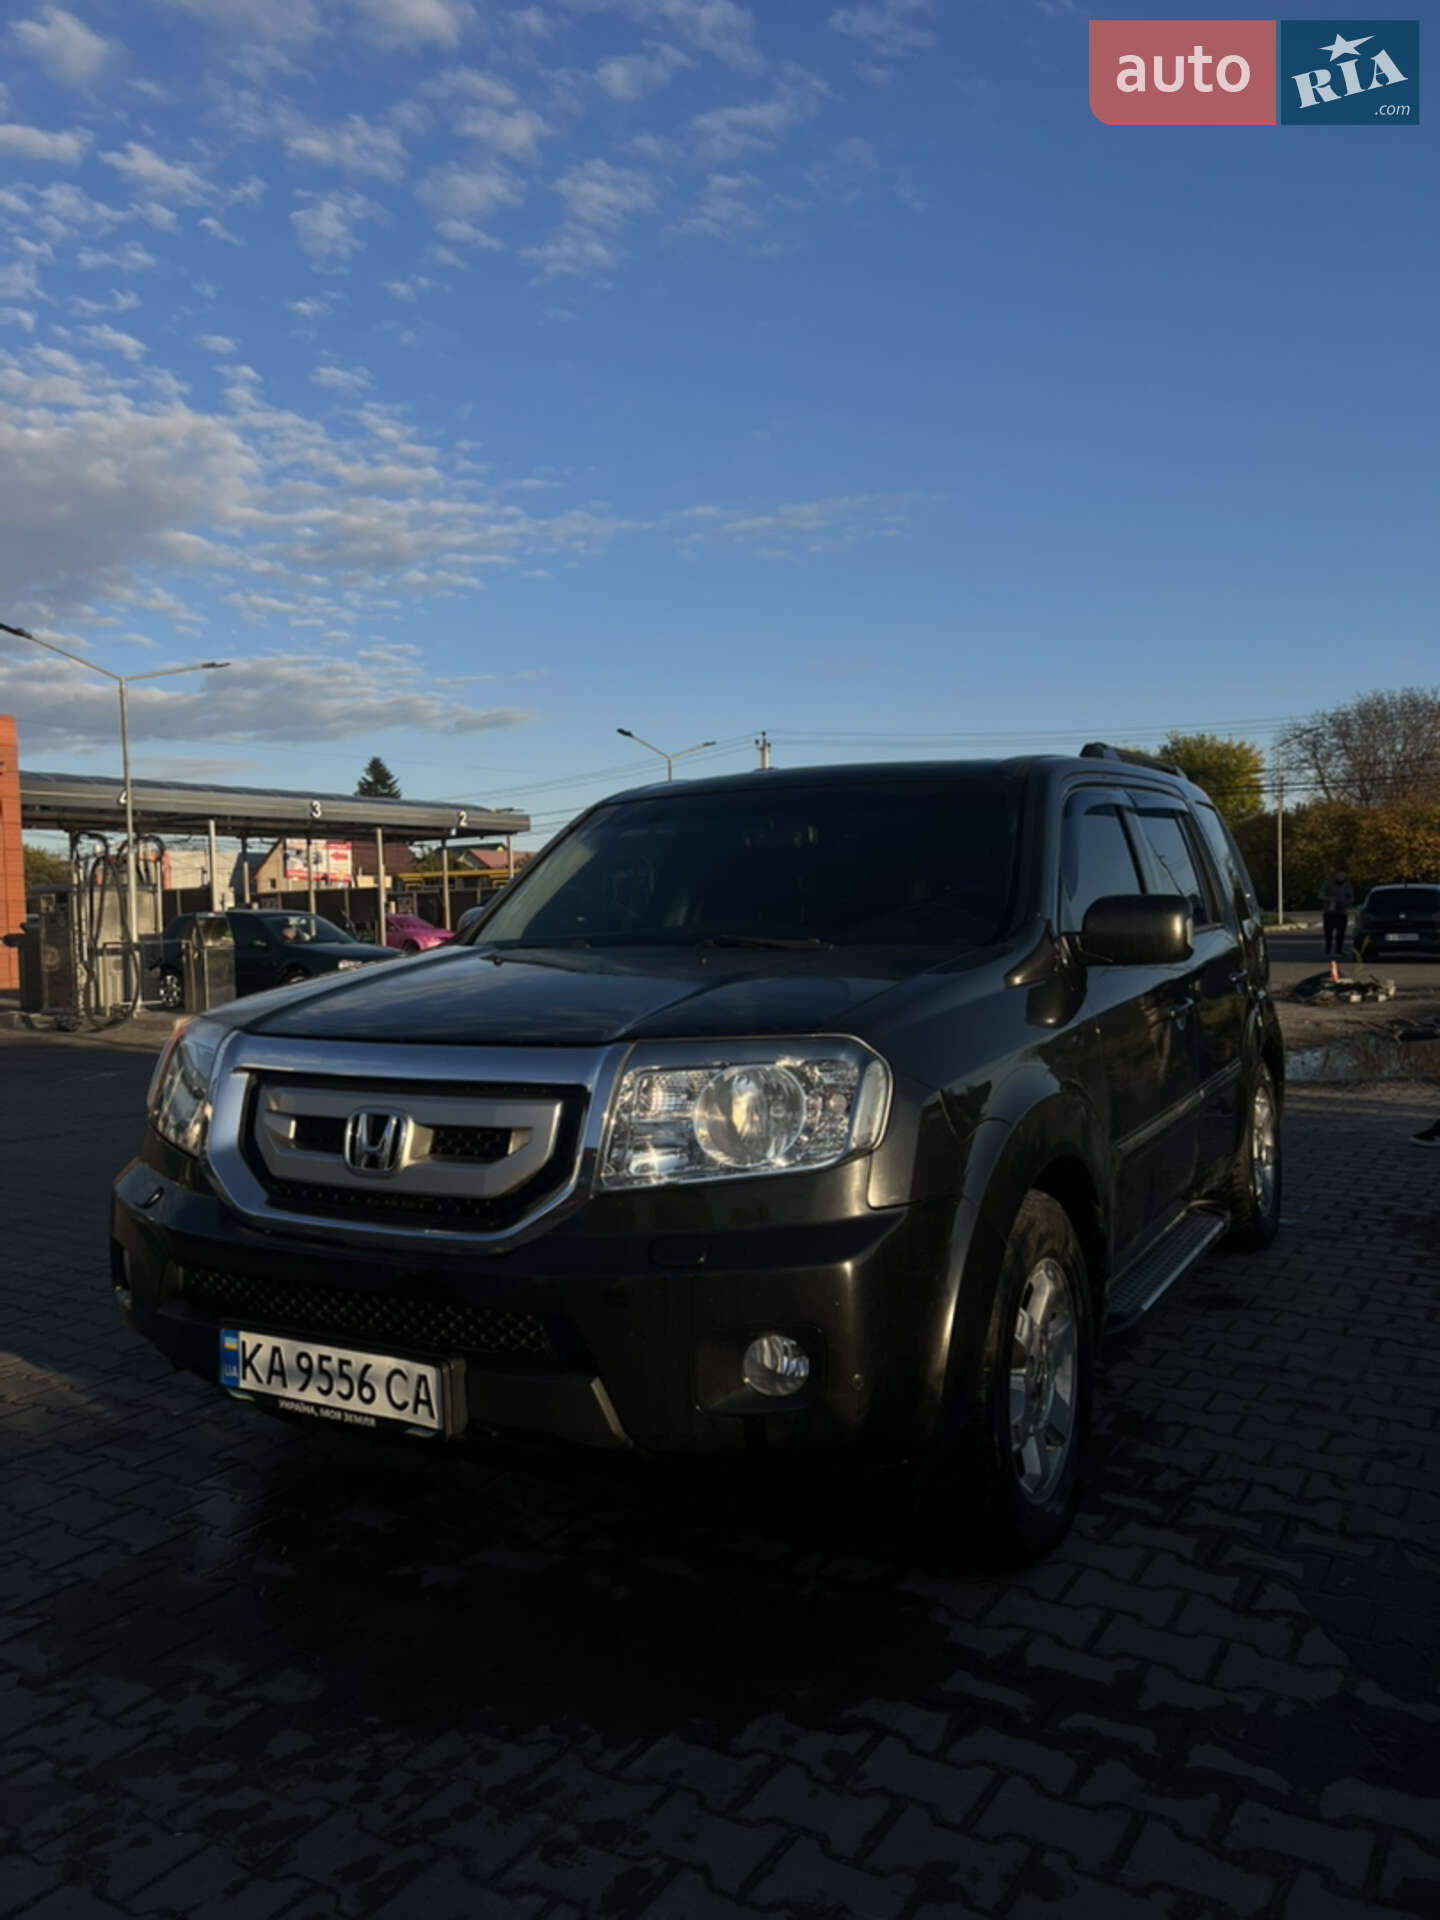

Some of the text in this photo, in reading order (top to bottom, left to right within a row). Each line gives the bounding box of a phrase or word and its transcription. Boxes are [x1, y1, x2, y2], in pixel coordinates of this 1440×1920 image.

[311, 801, 322, 818] 3
[458, 811, 468, 827] 2
[241, 1340, 435, 1418] KA 9556 CA
